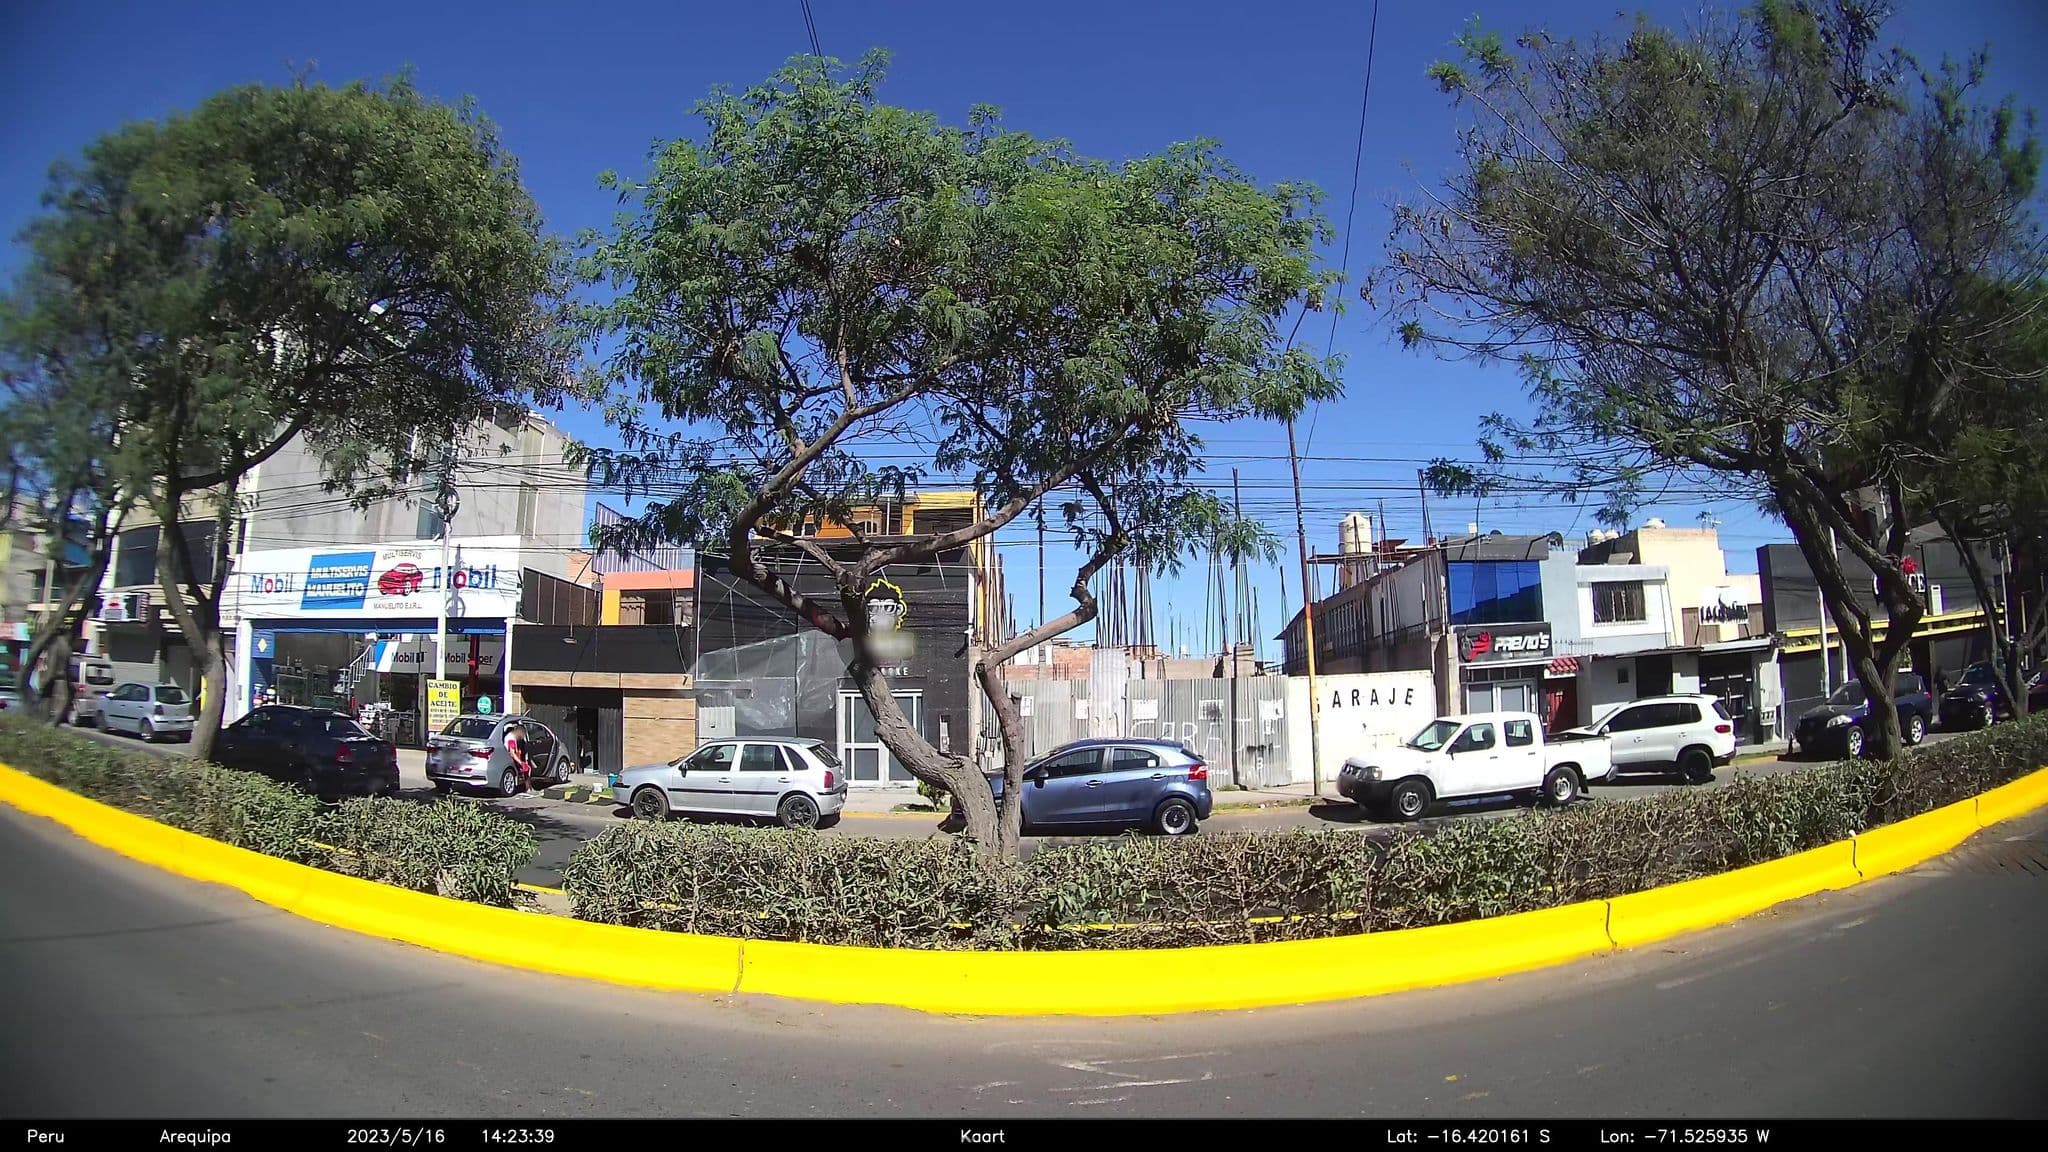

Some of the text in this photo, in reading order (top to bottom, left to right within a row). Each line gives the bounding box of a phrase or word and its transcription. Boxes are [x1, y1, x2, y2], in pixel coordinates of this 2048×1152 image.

[311, 565, 369, 579] MULTISERVIS
[432, 564, 497, 590] Mobil
[251, 574, 293, 594] Mobil
[306, 583, 365, 597] MANUELITO
[428, 682, 458, 690] CAMBIO
[430, 700, 457, 708] ACEITE
[1316, 687, 1414, 713] ARAJE
